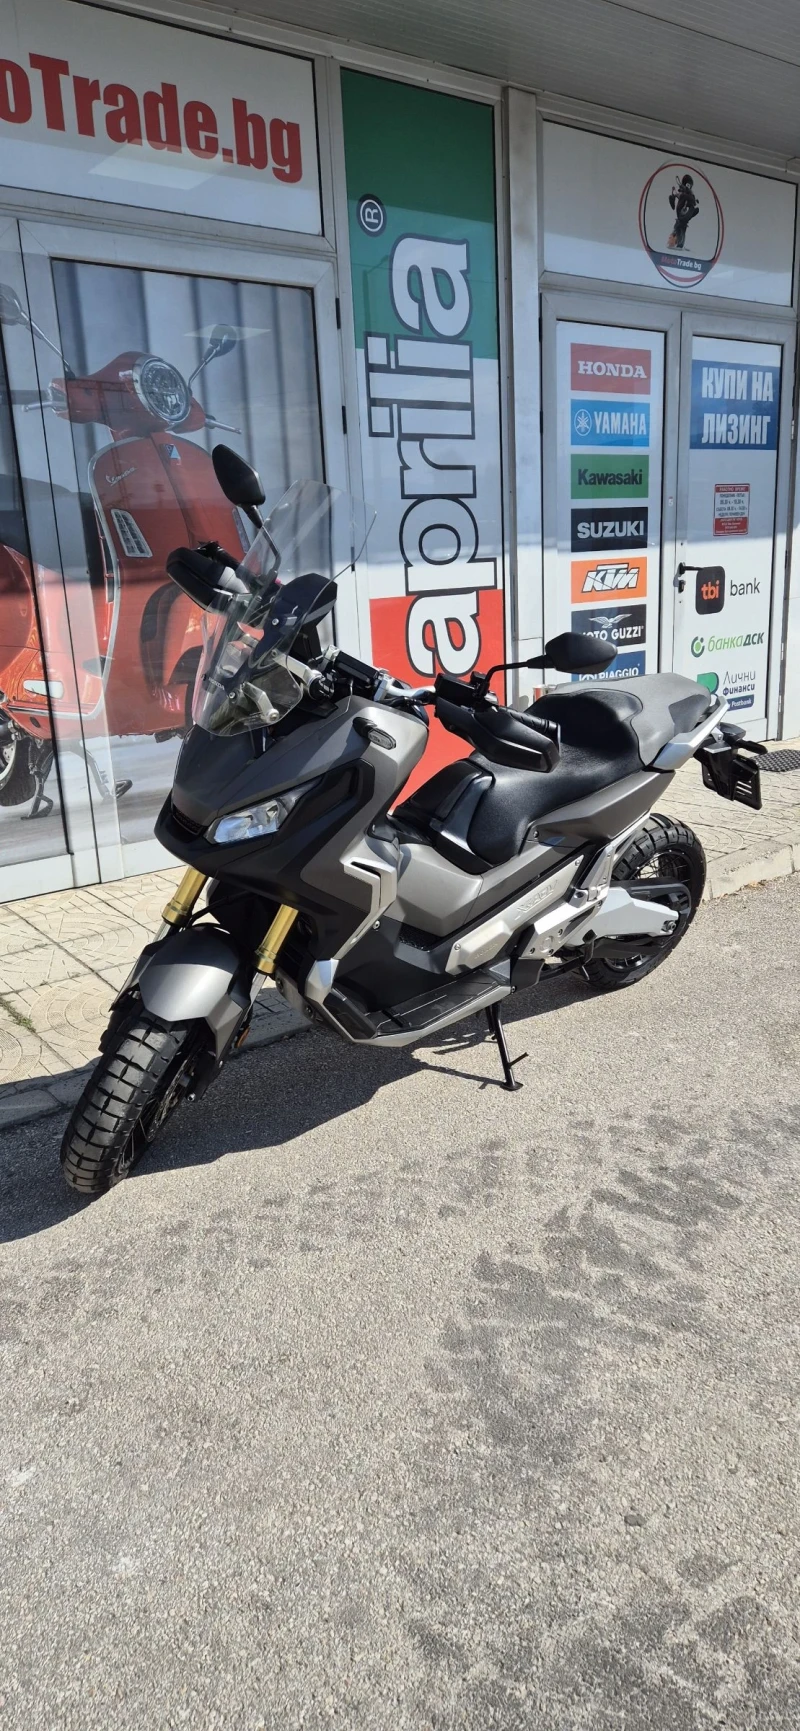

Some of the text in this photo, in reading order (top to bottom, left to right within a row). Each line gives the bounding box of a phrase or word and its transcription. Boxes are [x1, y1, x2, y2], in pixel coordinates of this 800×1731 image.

[577, 360, 647, 379] HONDA
[701, 366, 774, 402] КУПИ НА
[593, 410, 647, 435] YAMAHA
[701, 412, 771, 445] ЛИЗИНГ
[364, 232, 498, 678] aprilia
[577, 468, 643, 486] Kawasaki
[577, 520, 644, 539] SUZUKI
[582, 562, 640, 593] KTM
[701, 577, 761, 600] tbi bank
[611, 626, 641, 640] GUZZI
[723, 670, 756, 685] Лични
